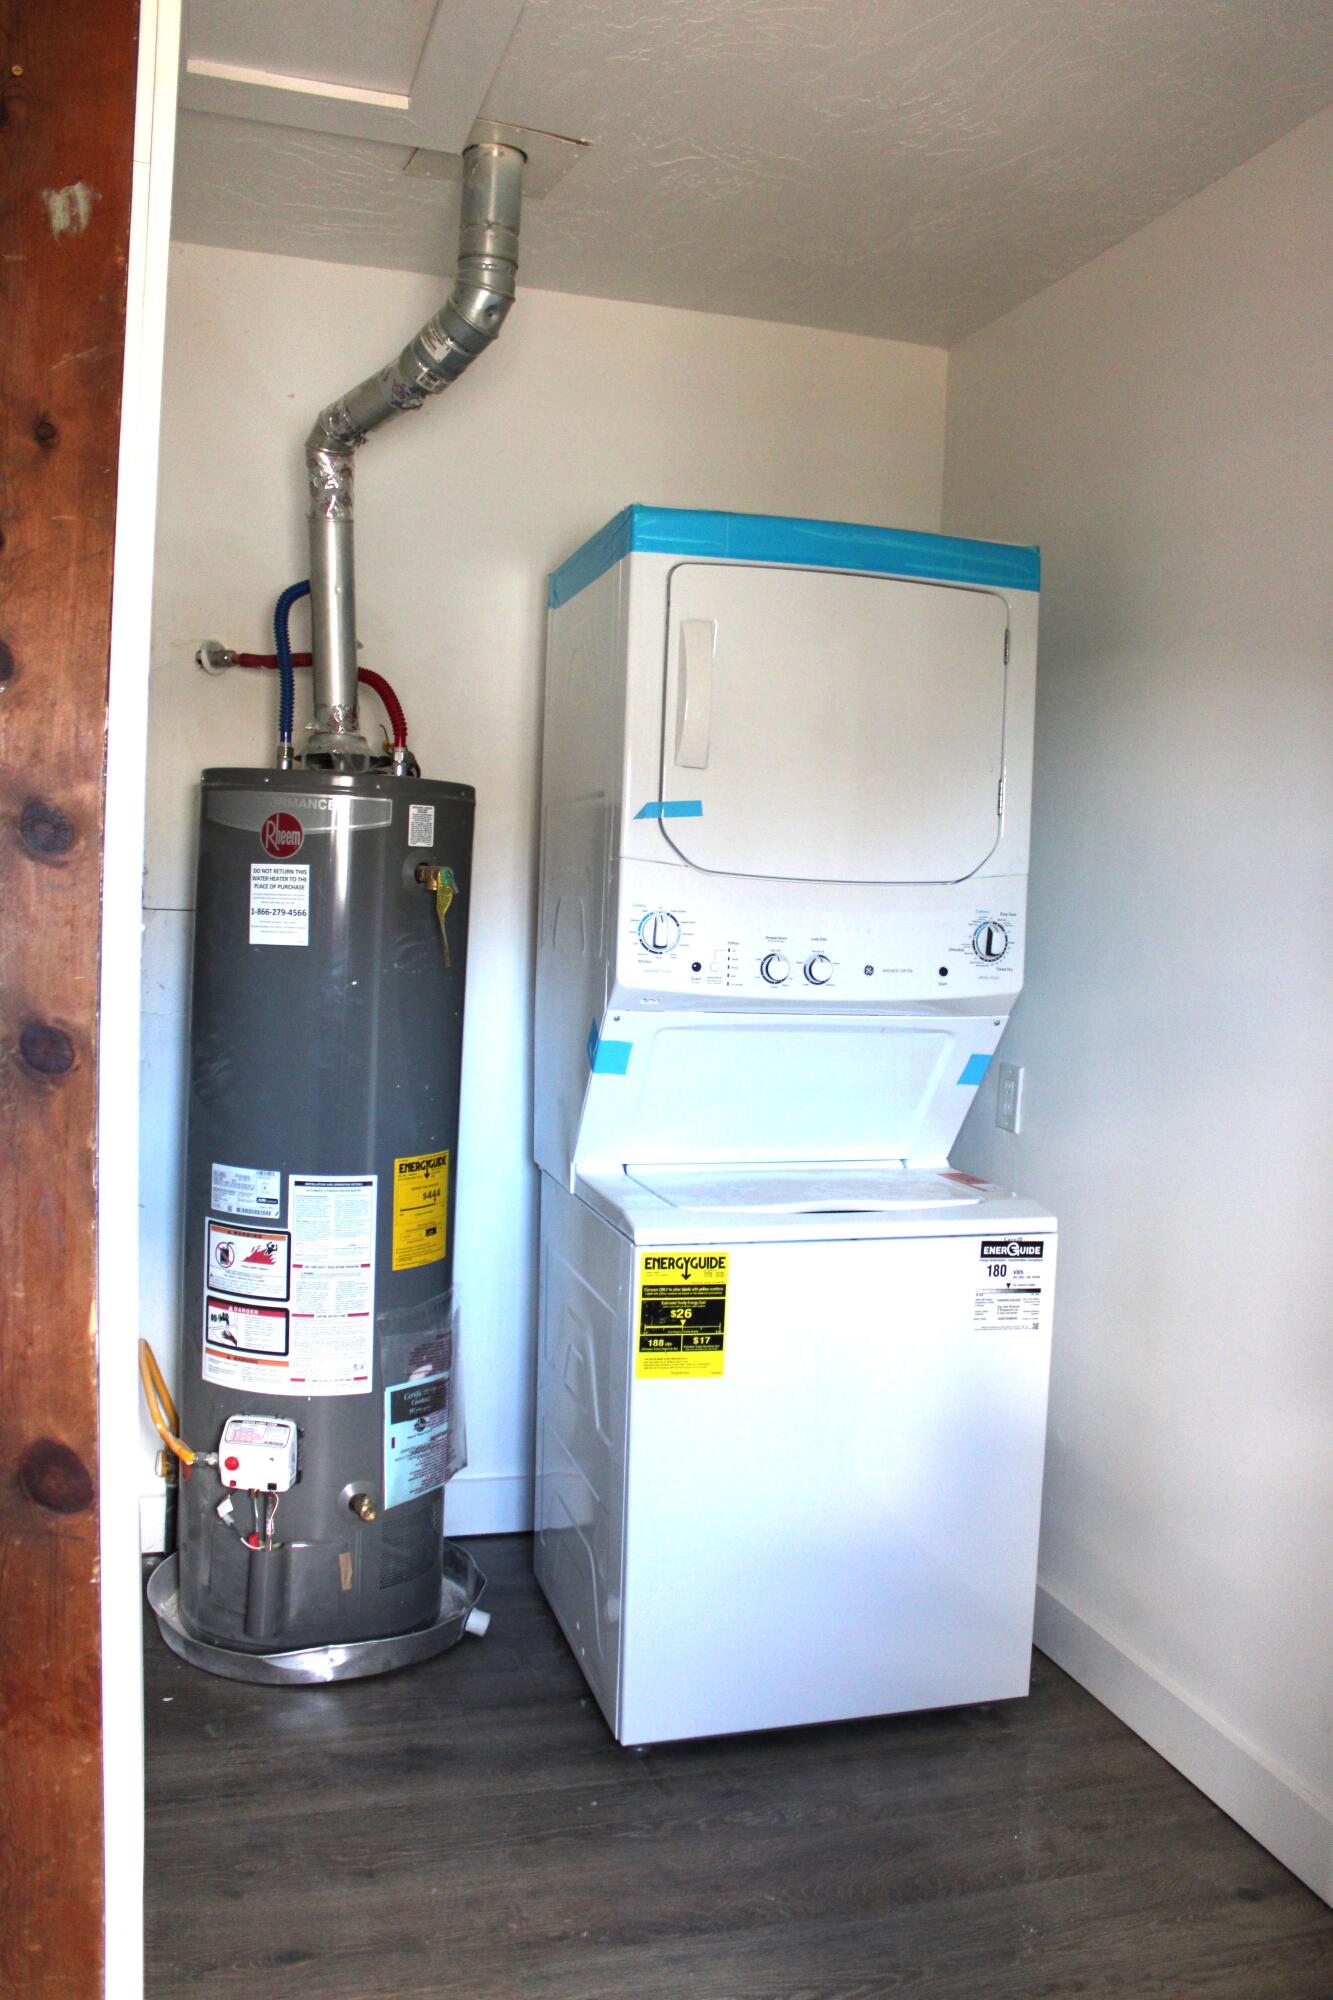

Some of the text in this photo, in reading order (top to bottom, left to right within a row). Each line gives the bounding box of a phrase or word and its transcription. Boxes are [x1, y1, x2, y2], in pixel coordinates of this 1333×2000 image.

[265, 812, 301, 851] Rheem
[251, 908, 307, 917] 1-866-279-4566
[984, 1242, 1041, 1256] ENERGUIDE
[645, 1257, 726, 1270] ENERGYGUIDE
[987, 1264, 1007, 1277] 180
[670, 1308, 692, 1319] $26
[648, 1339, 664, 1347] 188
[693, 1336, 711, 1345] $17
